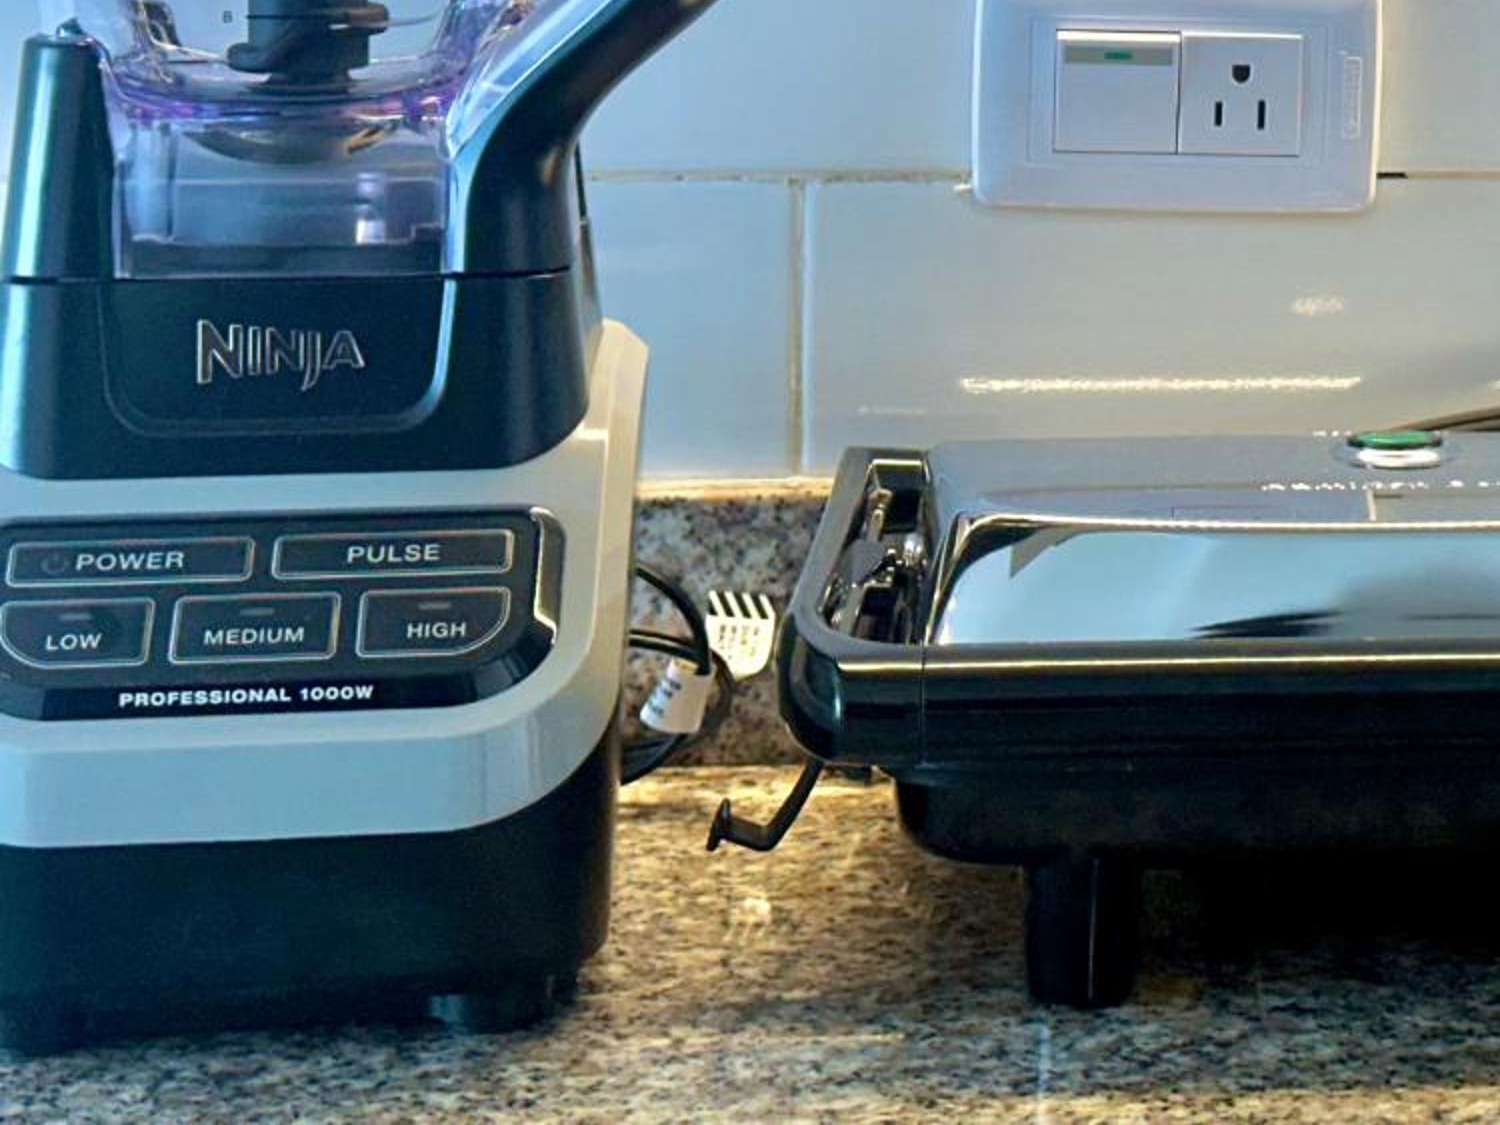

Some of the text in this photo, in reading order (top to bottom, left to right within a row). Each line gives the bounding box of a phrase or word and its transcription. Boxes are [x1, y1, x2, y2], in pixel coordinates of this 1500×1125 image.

[197, 318, 365, 391] NINJA
[75, 550, 185, 572] POWER
[346, 543, 440, 564] PULSE
[203, 627, 305, 646] MEDIUM
[405, 622, 467, 639] HIGH
[45, 632, 102, 651] LOW
[118, 685, 374, 707] PROFESSIONAL 1000W
